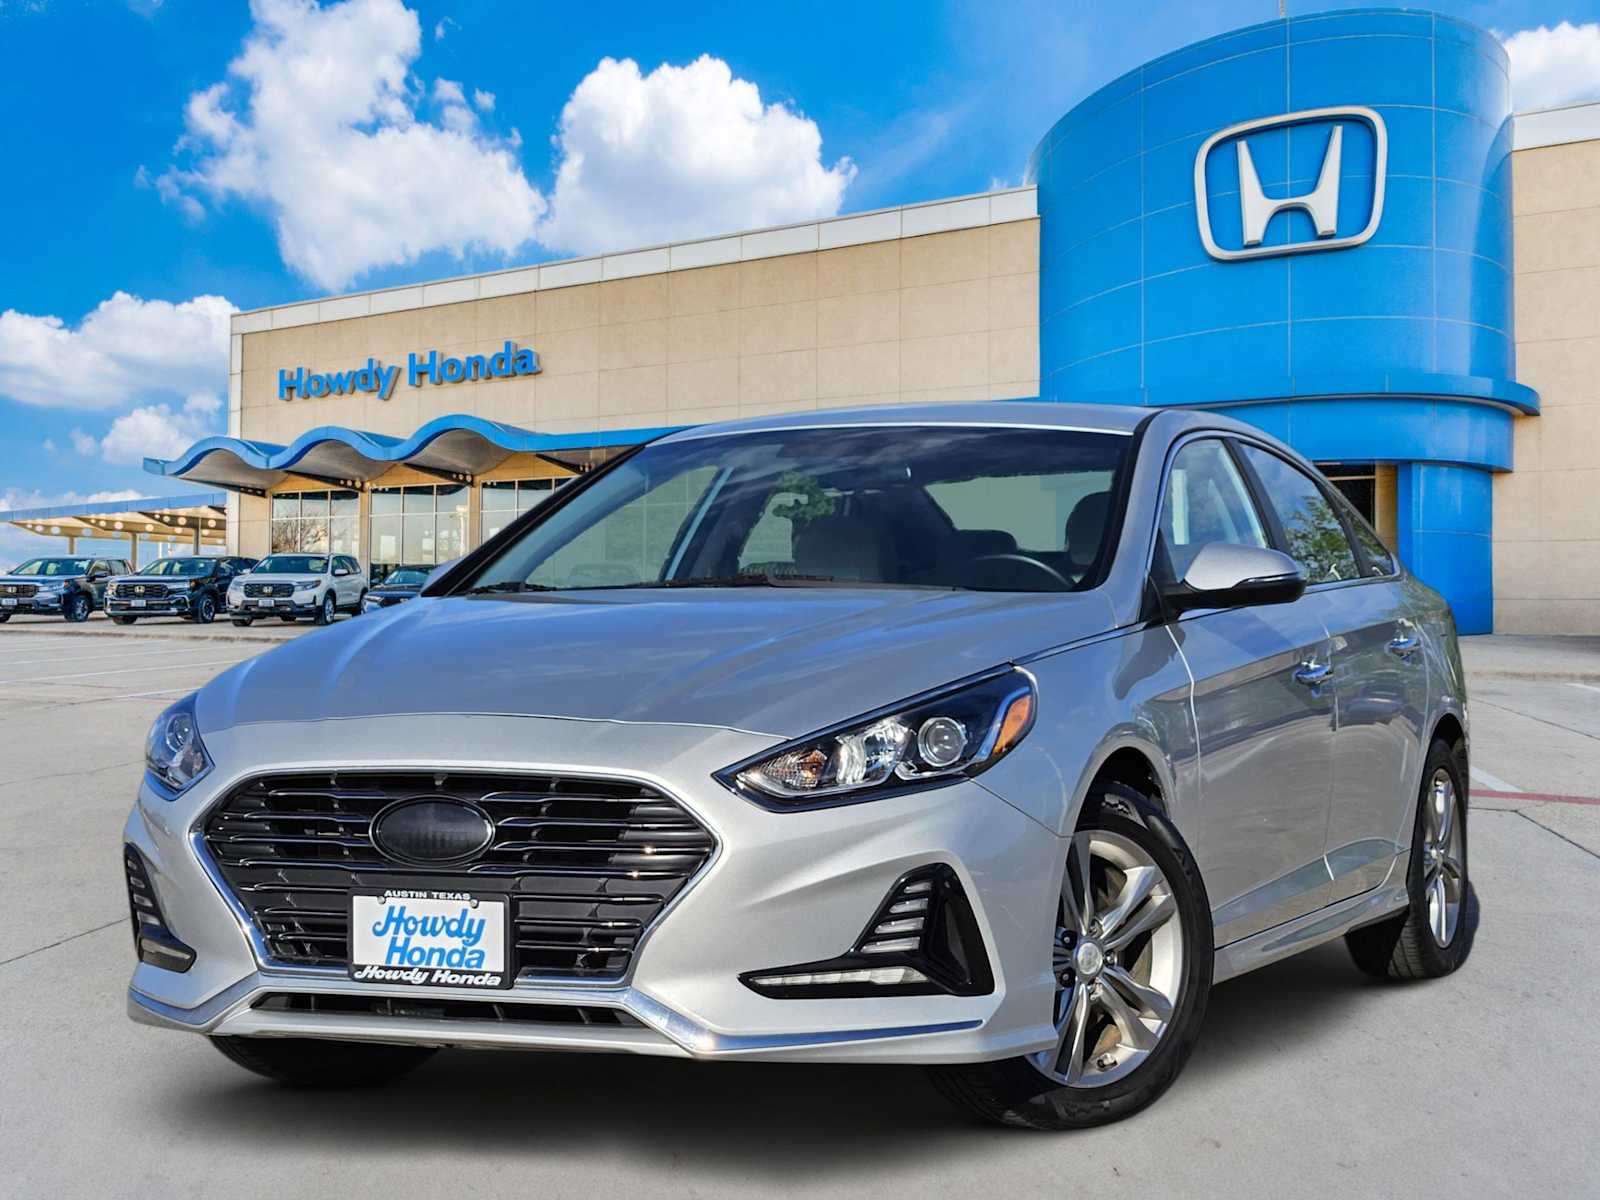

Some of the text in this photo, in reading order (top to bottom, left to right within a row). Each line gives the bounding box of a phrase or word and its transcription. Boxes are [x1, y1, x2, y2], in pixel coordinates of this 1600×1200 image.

[278, 340, 541, 400] Howdy Honda
[384, 890, 471, 901] AUSTIN TEXAS
[372, 905, 486, 947] Howdy
[385, 936, 486, 969] Honda
[354, 965, 502, 987] Howdy Honda
